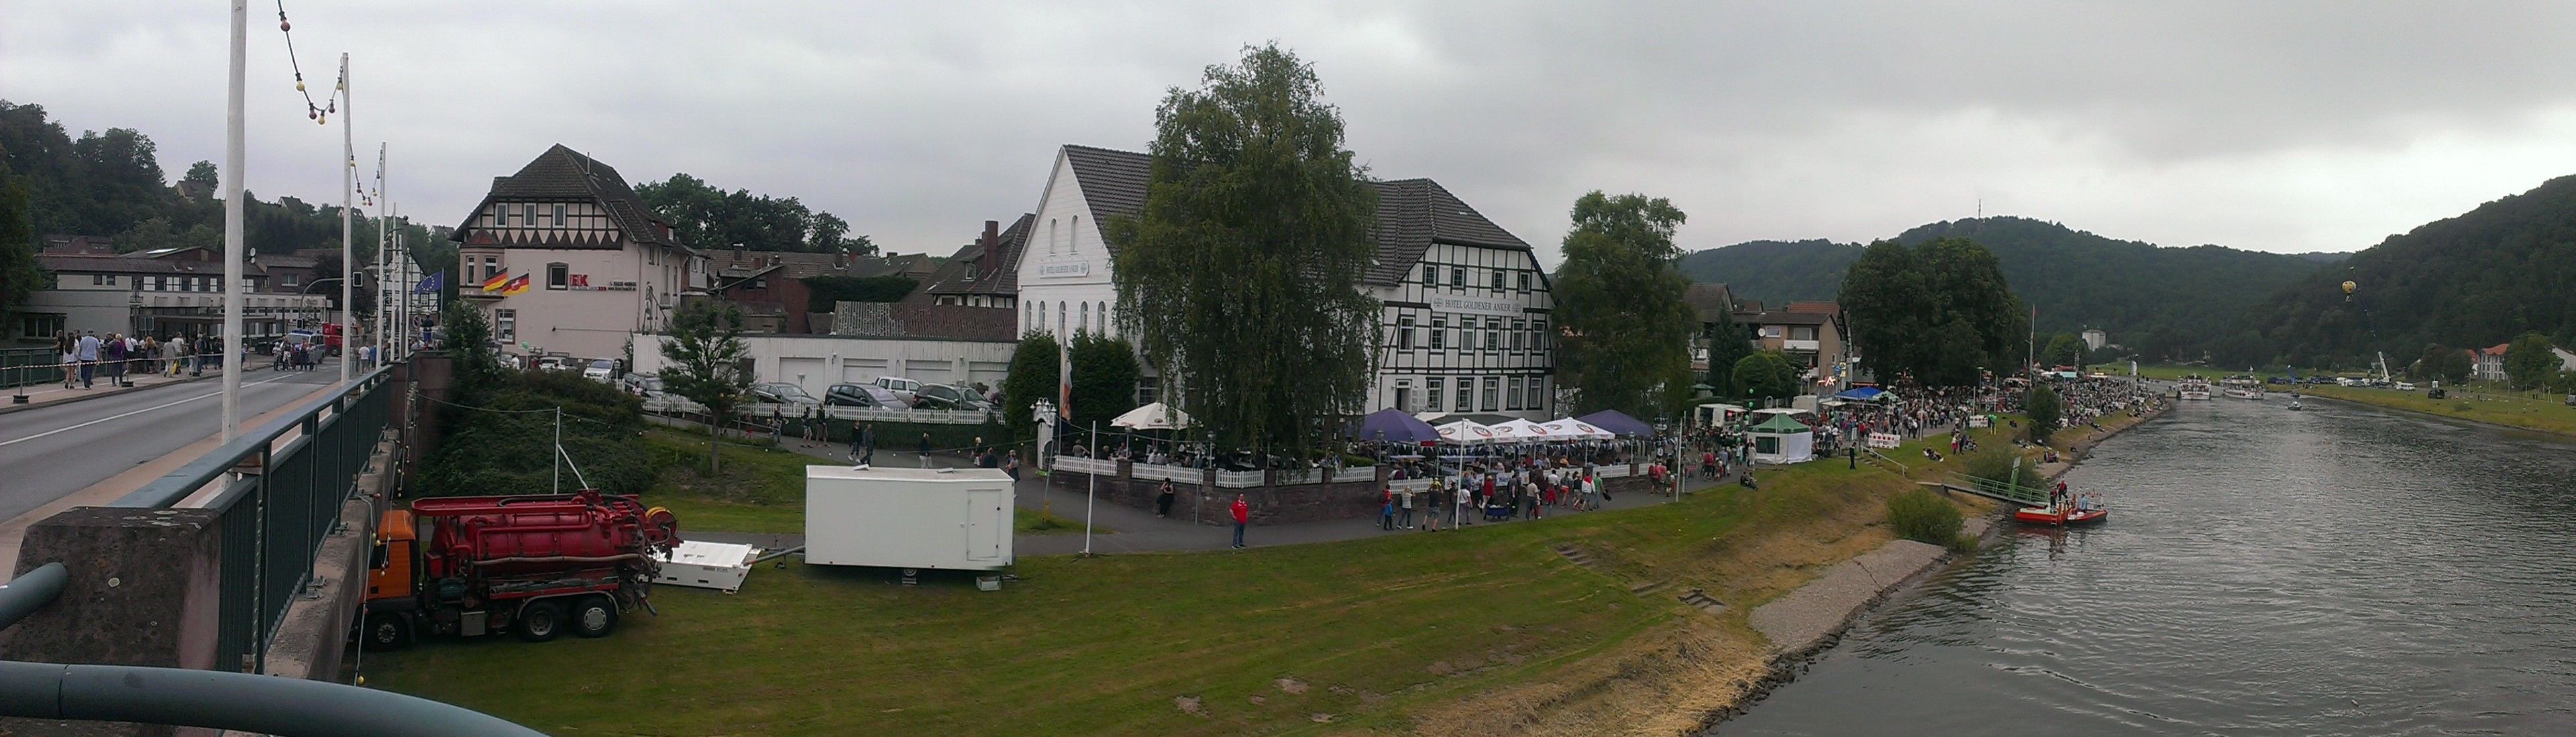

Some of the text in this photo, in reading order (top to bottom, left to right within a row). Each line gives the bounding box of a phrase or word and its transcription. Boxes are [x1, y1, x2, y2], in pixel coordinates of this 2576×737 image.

[1445, 299, 1511, 312] HOTEL GOLDENER ANKER
